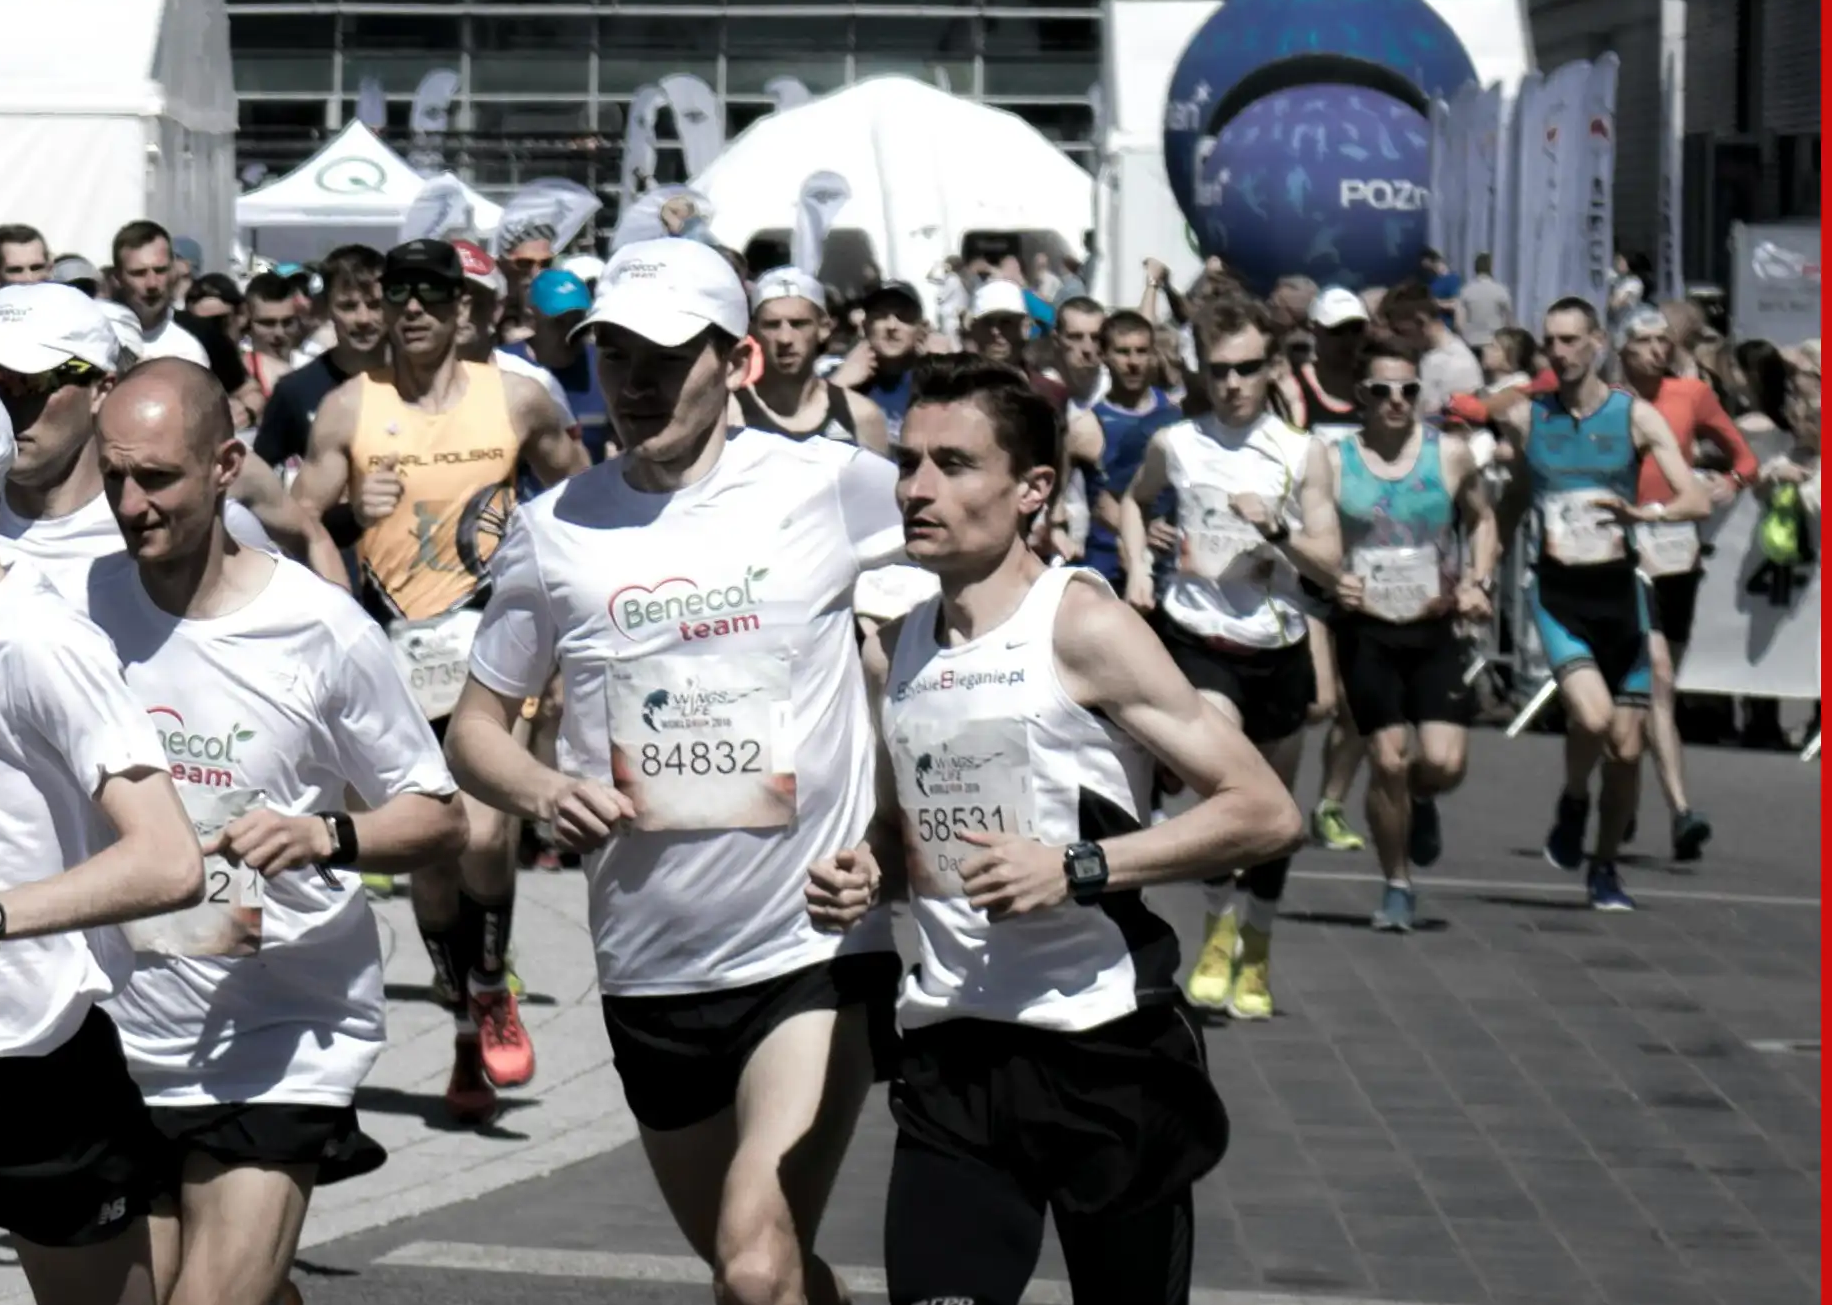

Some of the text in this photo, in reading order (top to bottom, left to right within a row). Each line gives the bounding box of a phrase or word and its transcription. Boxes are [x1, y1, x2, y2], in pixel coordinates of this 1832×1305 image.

[623, 576, 756, 631] Benecol
[679, 613, 760, 642] team
[170, 761, 234, 788] eam
[640, 739, 763, 777] 84832
